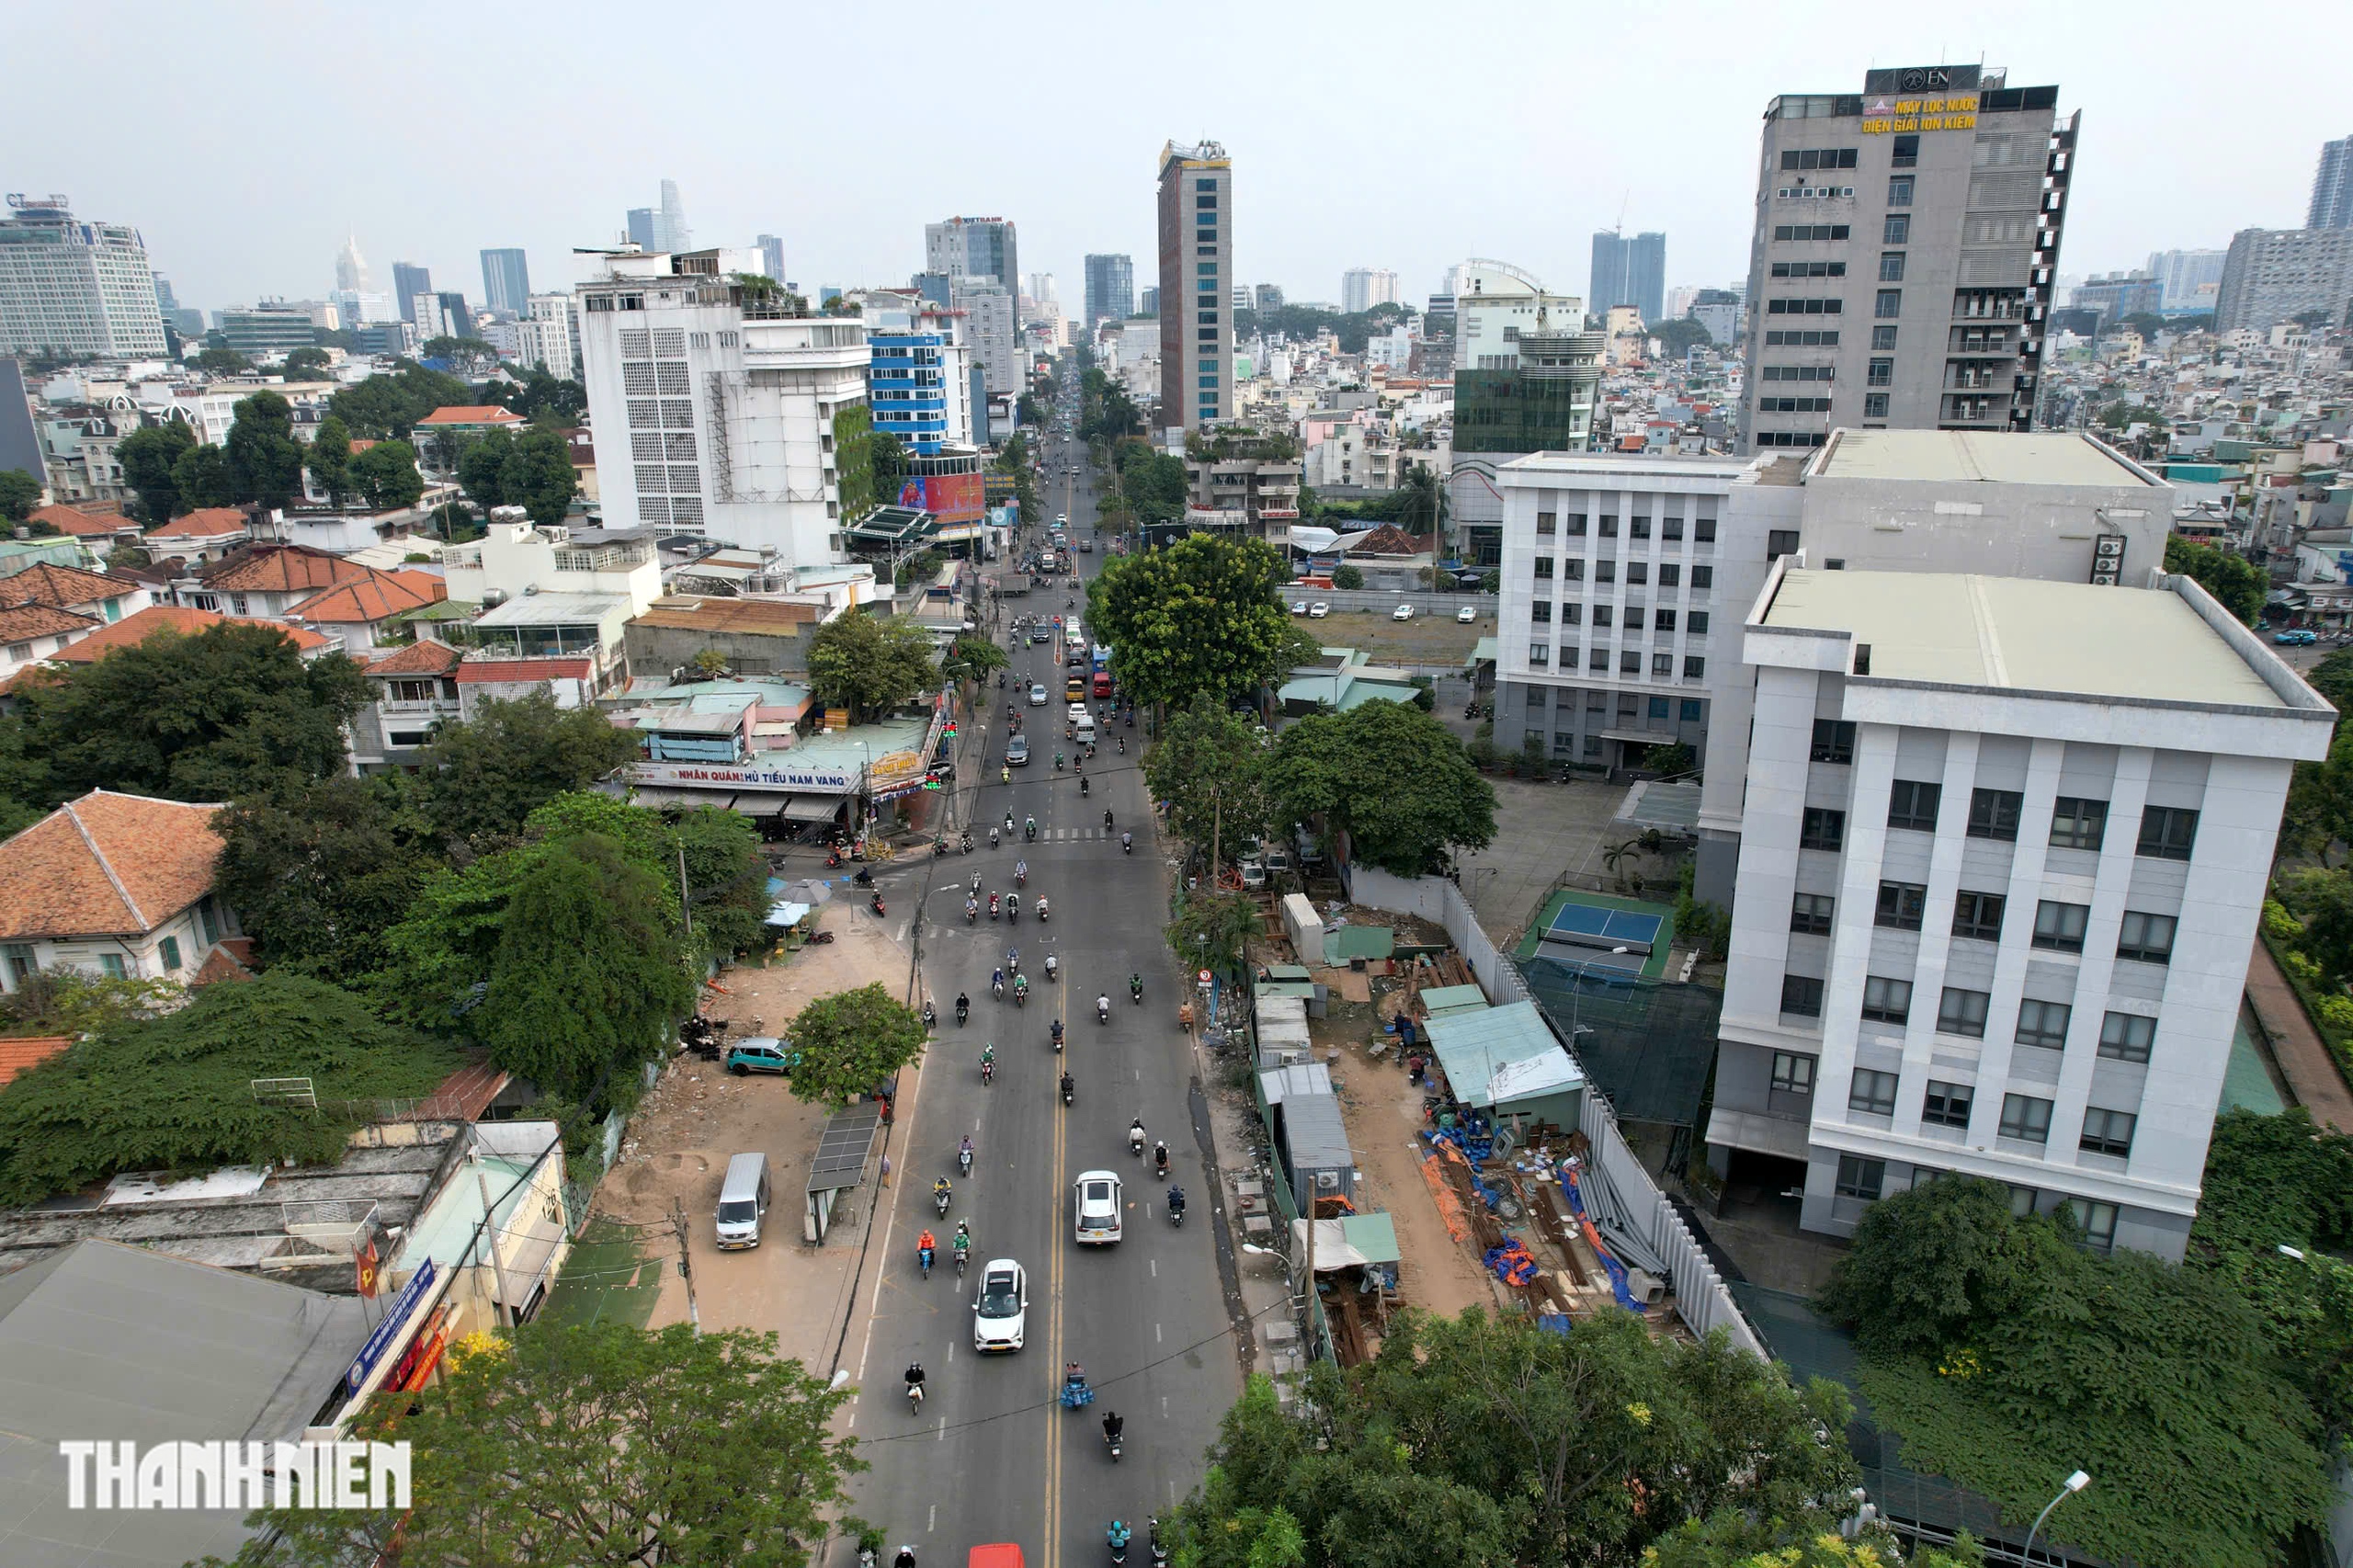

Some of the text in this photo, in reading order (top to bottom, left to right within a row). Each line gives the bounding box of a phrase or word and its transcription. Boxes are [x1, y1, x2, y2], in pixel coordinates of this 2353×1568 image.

[1920, 117, 1942, 131] ION
[678, 768, 709, 780] NHÂN
[711, 770, 739, 781] QUÁN
[745, 770, 759, 782] HỦ
[762, 771, 786, 783] TIẾU
[790, 775, 813, 785] NAM
[815, 776, 845, 786] VANG
